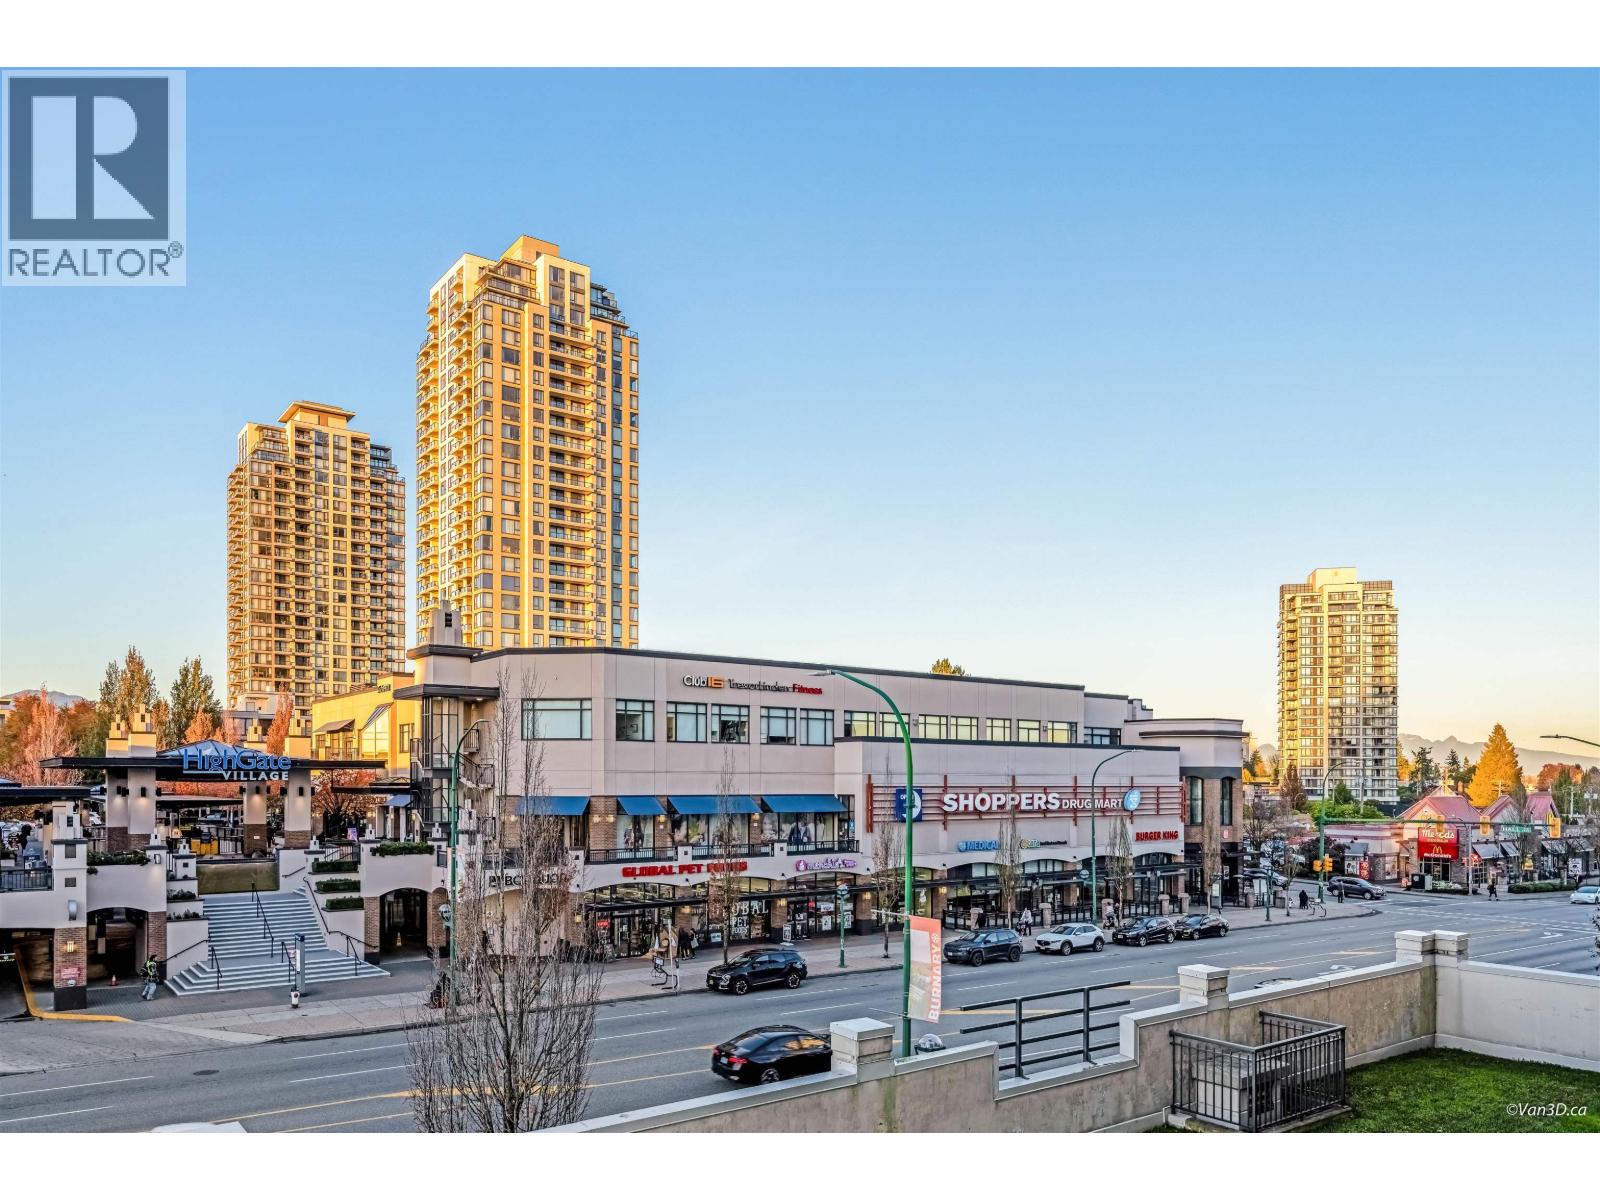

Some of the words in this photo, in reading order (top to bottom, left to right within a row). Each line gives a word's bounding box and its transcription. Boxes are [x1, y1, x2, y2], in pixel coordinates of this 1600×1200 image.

[792, 683, 823, 695] Fitness
[183, 748, 292, 772] HighGate
[222, 771, 289, 781] VILLAGE
[942, 792, 1061, 812] SHOPPERS
[1062, 799, 1092, 809] DRUG
[1094, 798, 1123, 809] MART
[1135, 831, 1161, 841] BURGER
[1162, 831, 1179, 840] KING
[622, 865, 674, 877] GLOBAL
[678, 864, 703, 874] PET
[505, 875, 522, 886] BC
[731, 916, 748, 928] PET
[928, 945, 941, 1020] BURNABY
